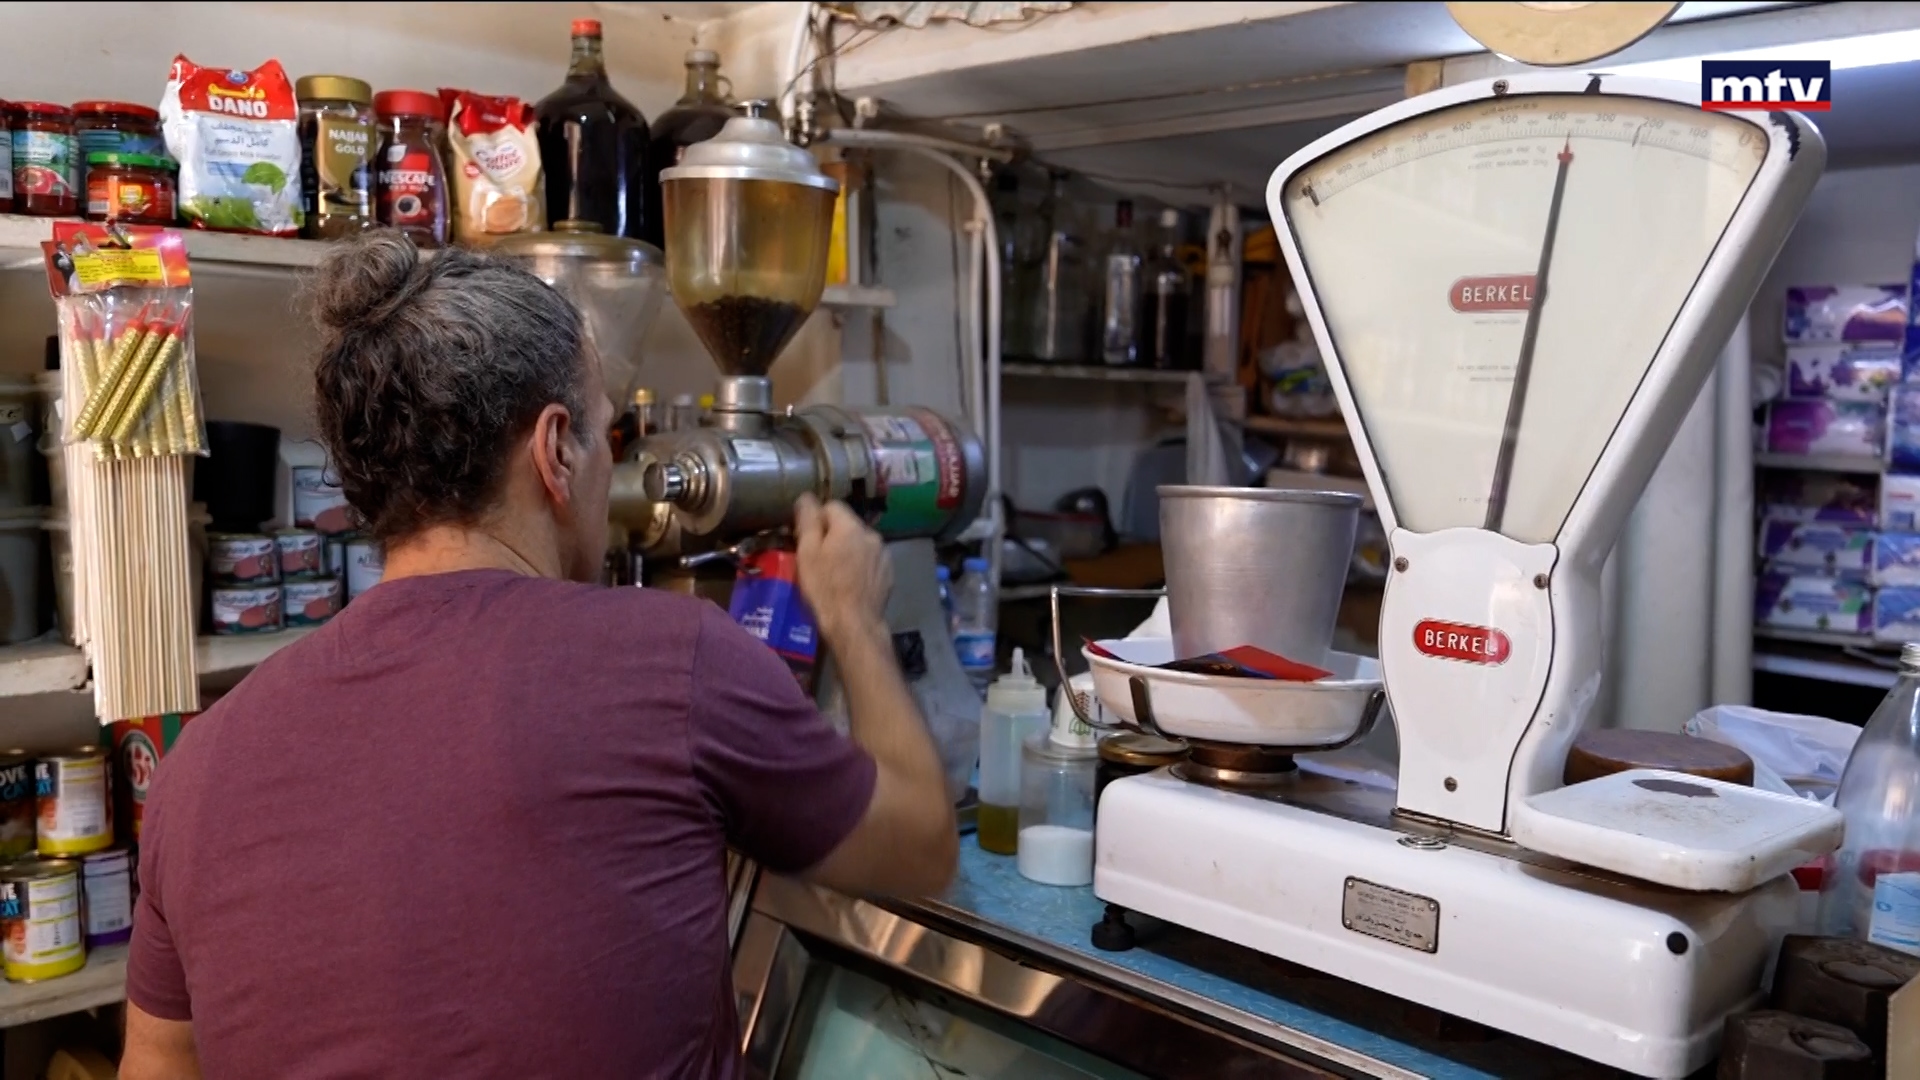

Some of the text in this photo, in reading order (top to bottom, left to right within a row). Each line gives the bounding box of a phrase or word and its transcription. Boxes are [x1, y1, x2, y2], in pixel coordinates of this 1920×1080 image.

[208, 95, 268, 118] DANO
[1500, 115, 1519, 125] 500
[1547, 111, 1567, 121] 400
[1452, 121, 1472, 133] 600
[335, 143, 365, 156] GOLD
[1462, 285, 1533, 304] BERKEL
[1424, 629, 1498, 656] BERKEL
